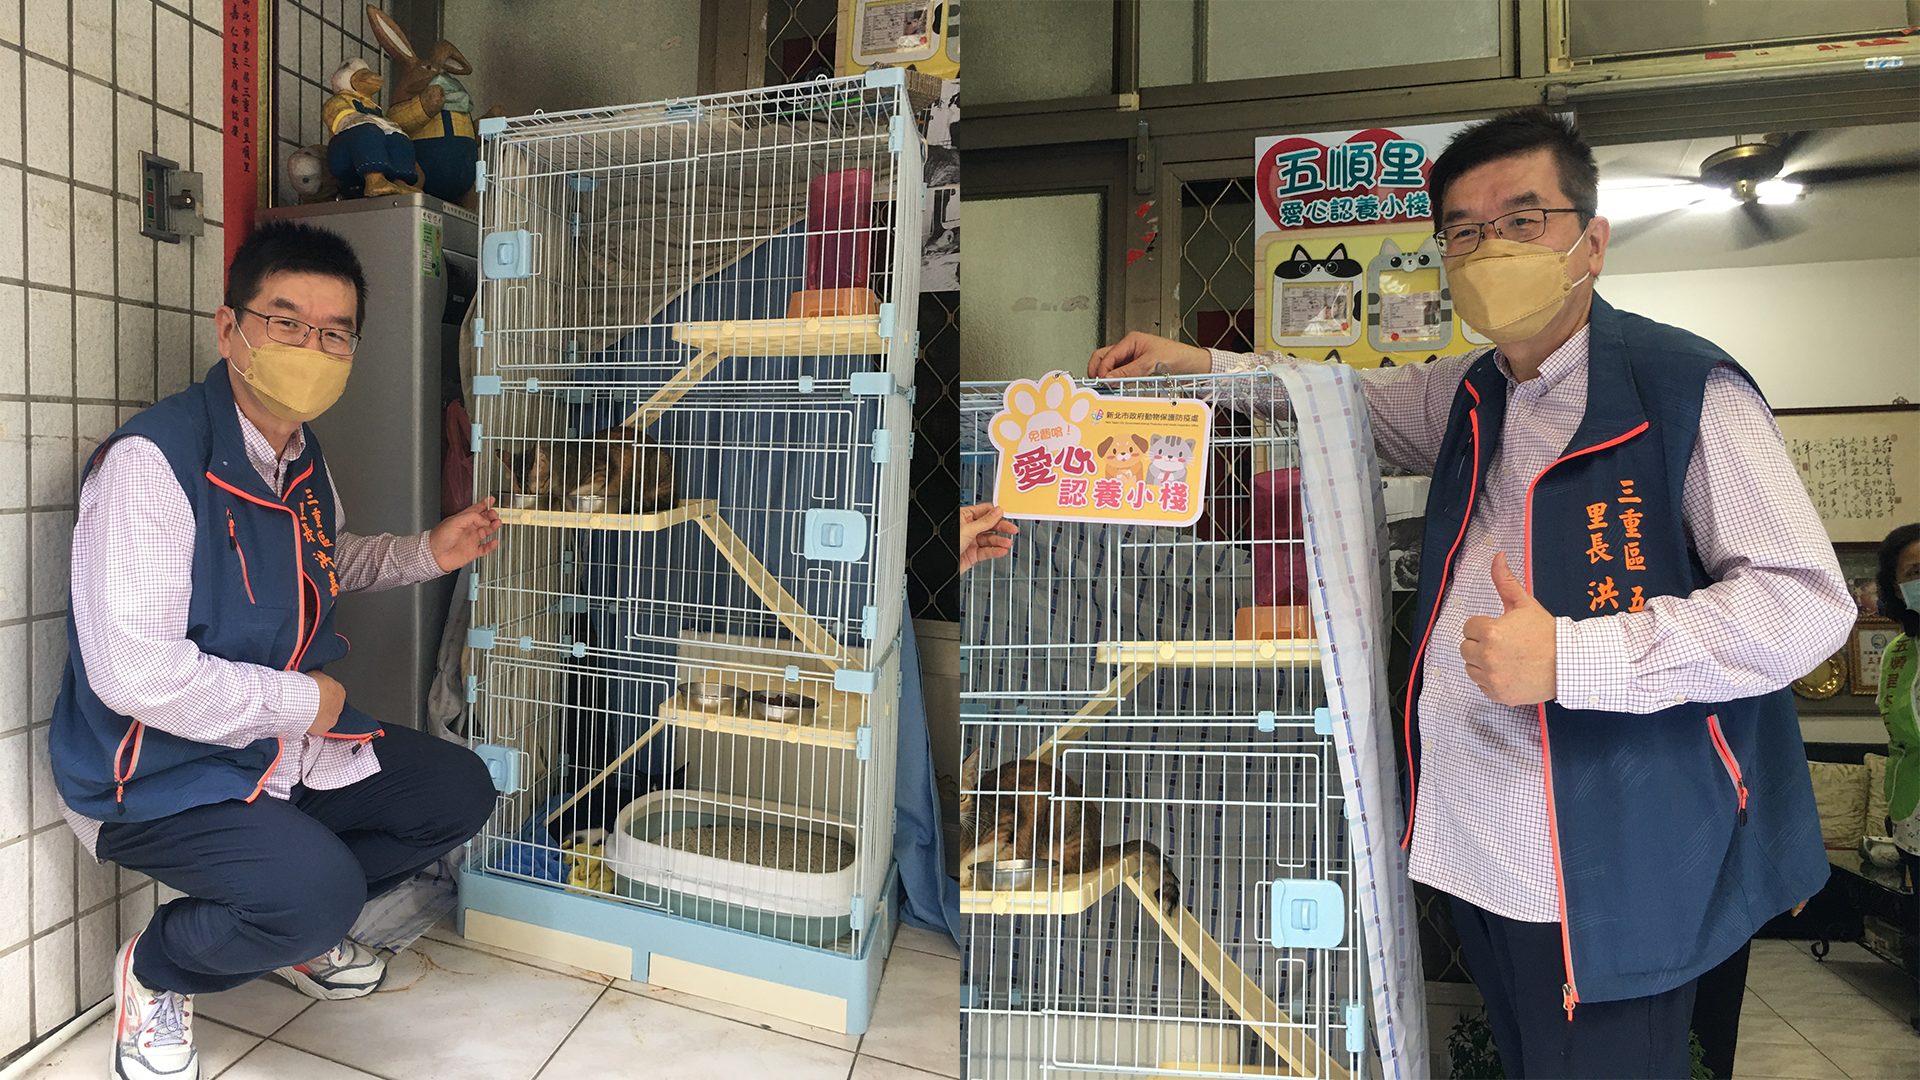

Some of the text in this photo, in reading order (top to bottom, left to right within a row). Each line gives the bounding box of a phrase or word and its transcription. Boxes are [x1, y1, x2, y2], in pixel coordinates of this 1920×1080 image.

[1278, 141, 1425, 197] 五順里
[1280, 193, 1431, 224] 愛心認養小棧
[1106, 411, 1199, 422] 新北市政府動物保護防疫處
[1013, 445, 1095, 491] 愛心
[1059, 478, 1189, 512] 認養小棧
[1617, 479, 1646, 571] 三重區
[1585, 502, 1619, 616] 里長 洪
